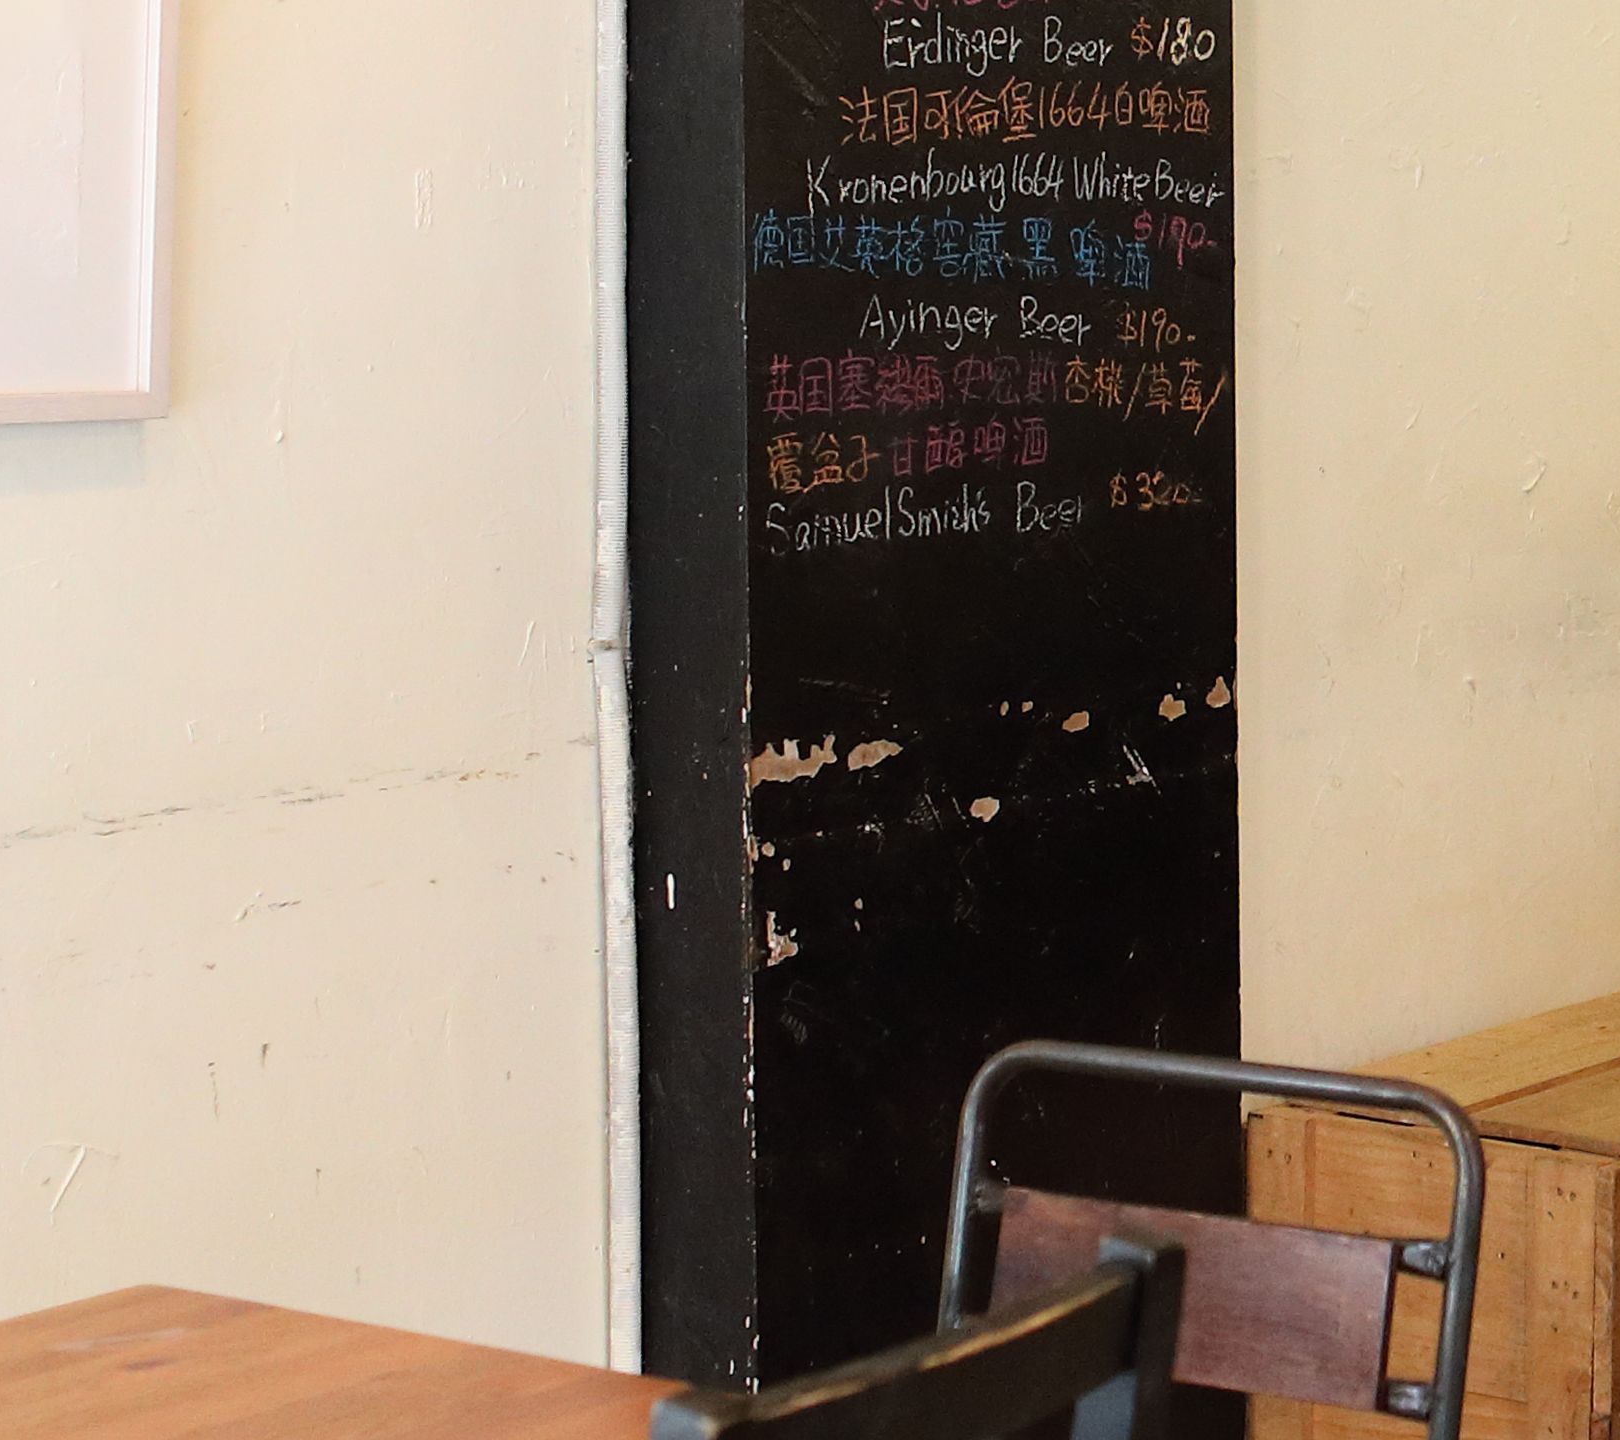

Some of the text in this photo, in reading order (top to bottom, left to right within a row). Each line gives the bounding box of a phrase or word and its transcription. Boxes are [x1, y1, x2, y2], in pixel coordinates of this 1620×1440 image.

[883, 12, 1216, 77] Erdinger Beer $180
[807, 146, 1225, 216] Kronenbourg 1664 White Beer
[859, 293, 997, 350] Ayinger
[1019, 294, 1091, 346] Beer
[1015, 481, 1083, 534] Beer
